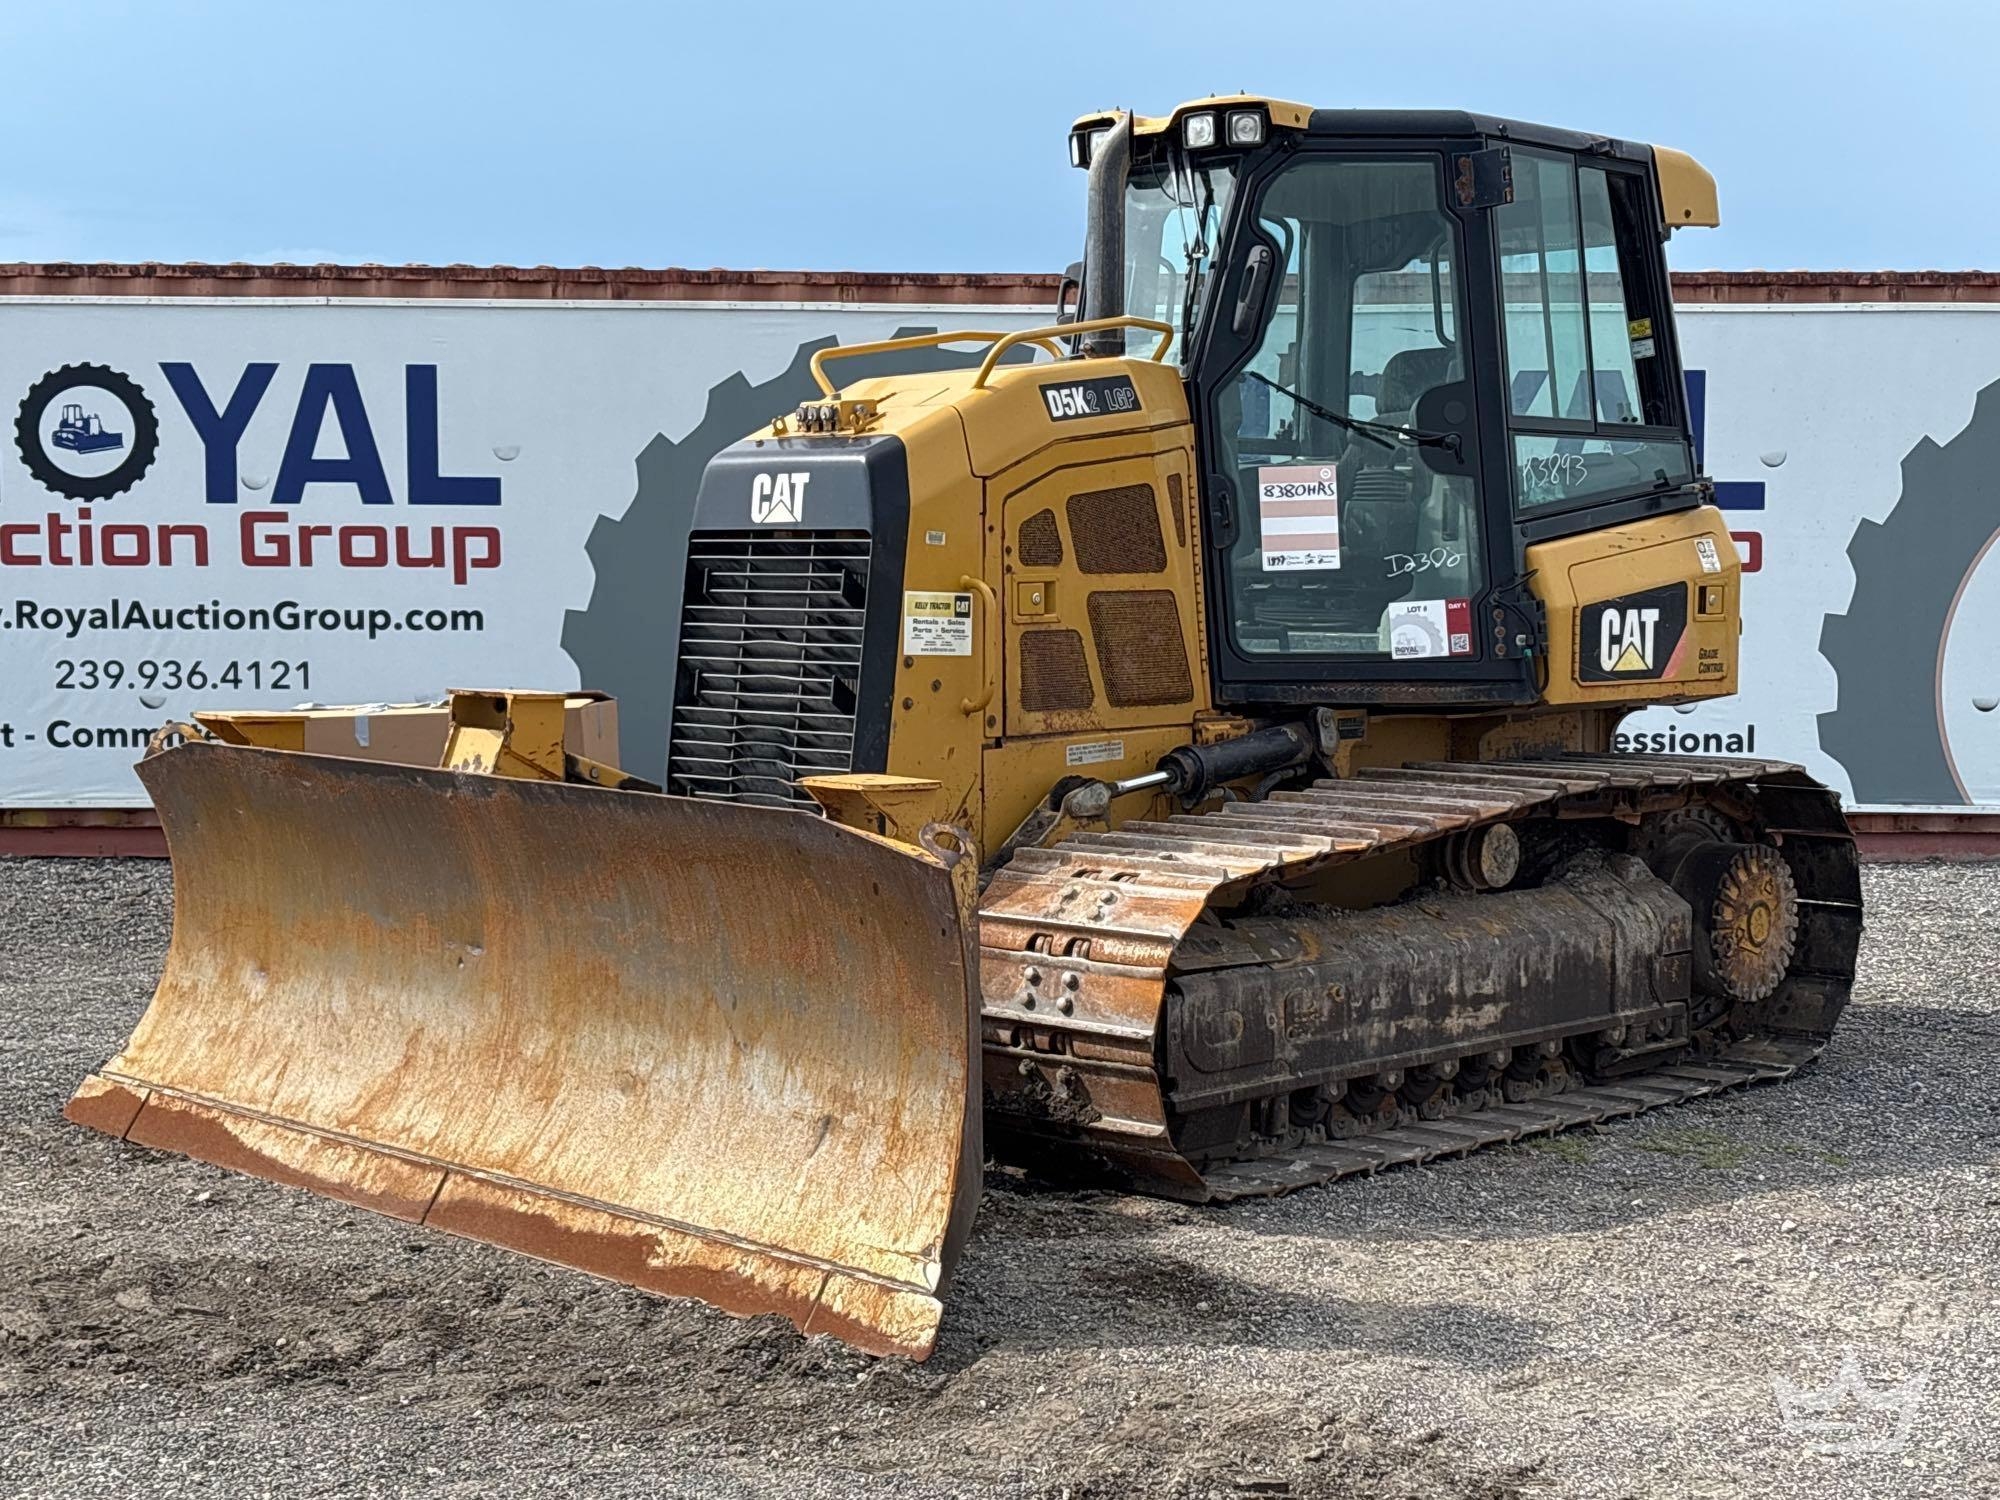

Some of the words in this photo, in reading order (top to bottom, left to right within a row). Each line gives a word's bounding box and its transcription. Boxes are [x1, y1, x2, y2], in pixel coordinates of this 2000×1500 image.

[1104, 387, 1135, 411] LGP
[751, 472, 810, 523] CAT
[0, 507, 209, 567] ction
[240, 511, 502, 585] Group
[0, 599, 485, 639] .RoyalAuctionGroup.com
[956, 601, 969, 612] CAT
[1407, 605, 1421, 613] LOT
[1600, 608, 1660, 672] CAT
[55, 660, 311, 690] 239.936.4121
[1614, 724, 1755, 753] essional
